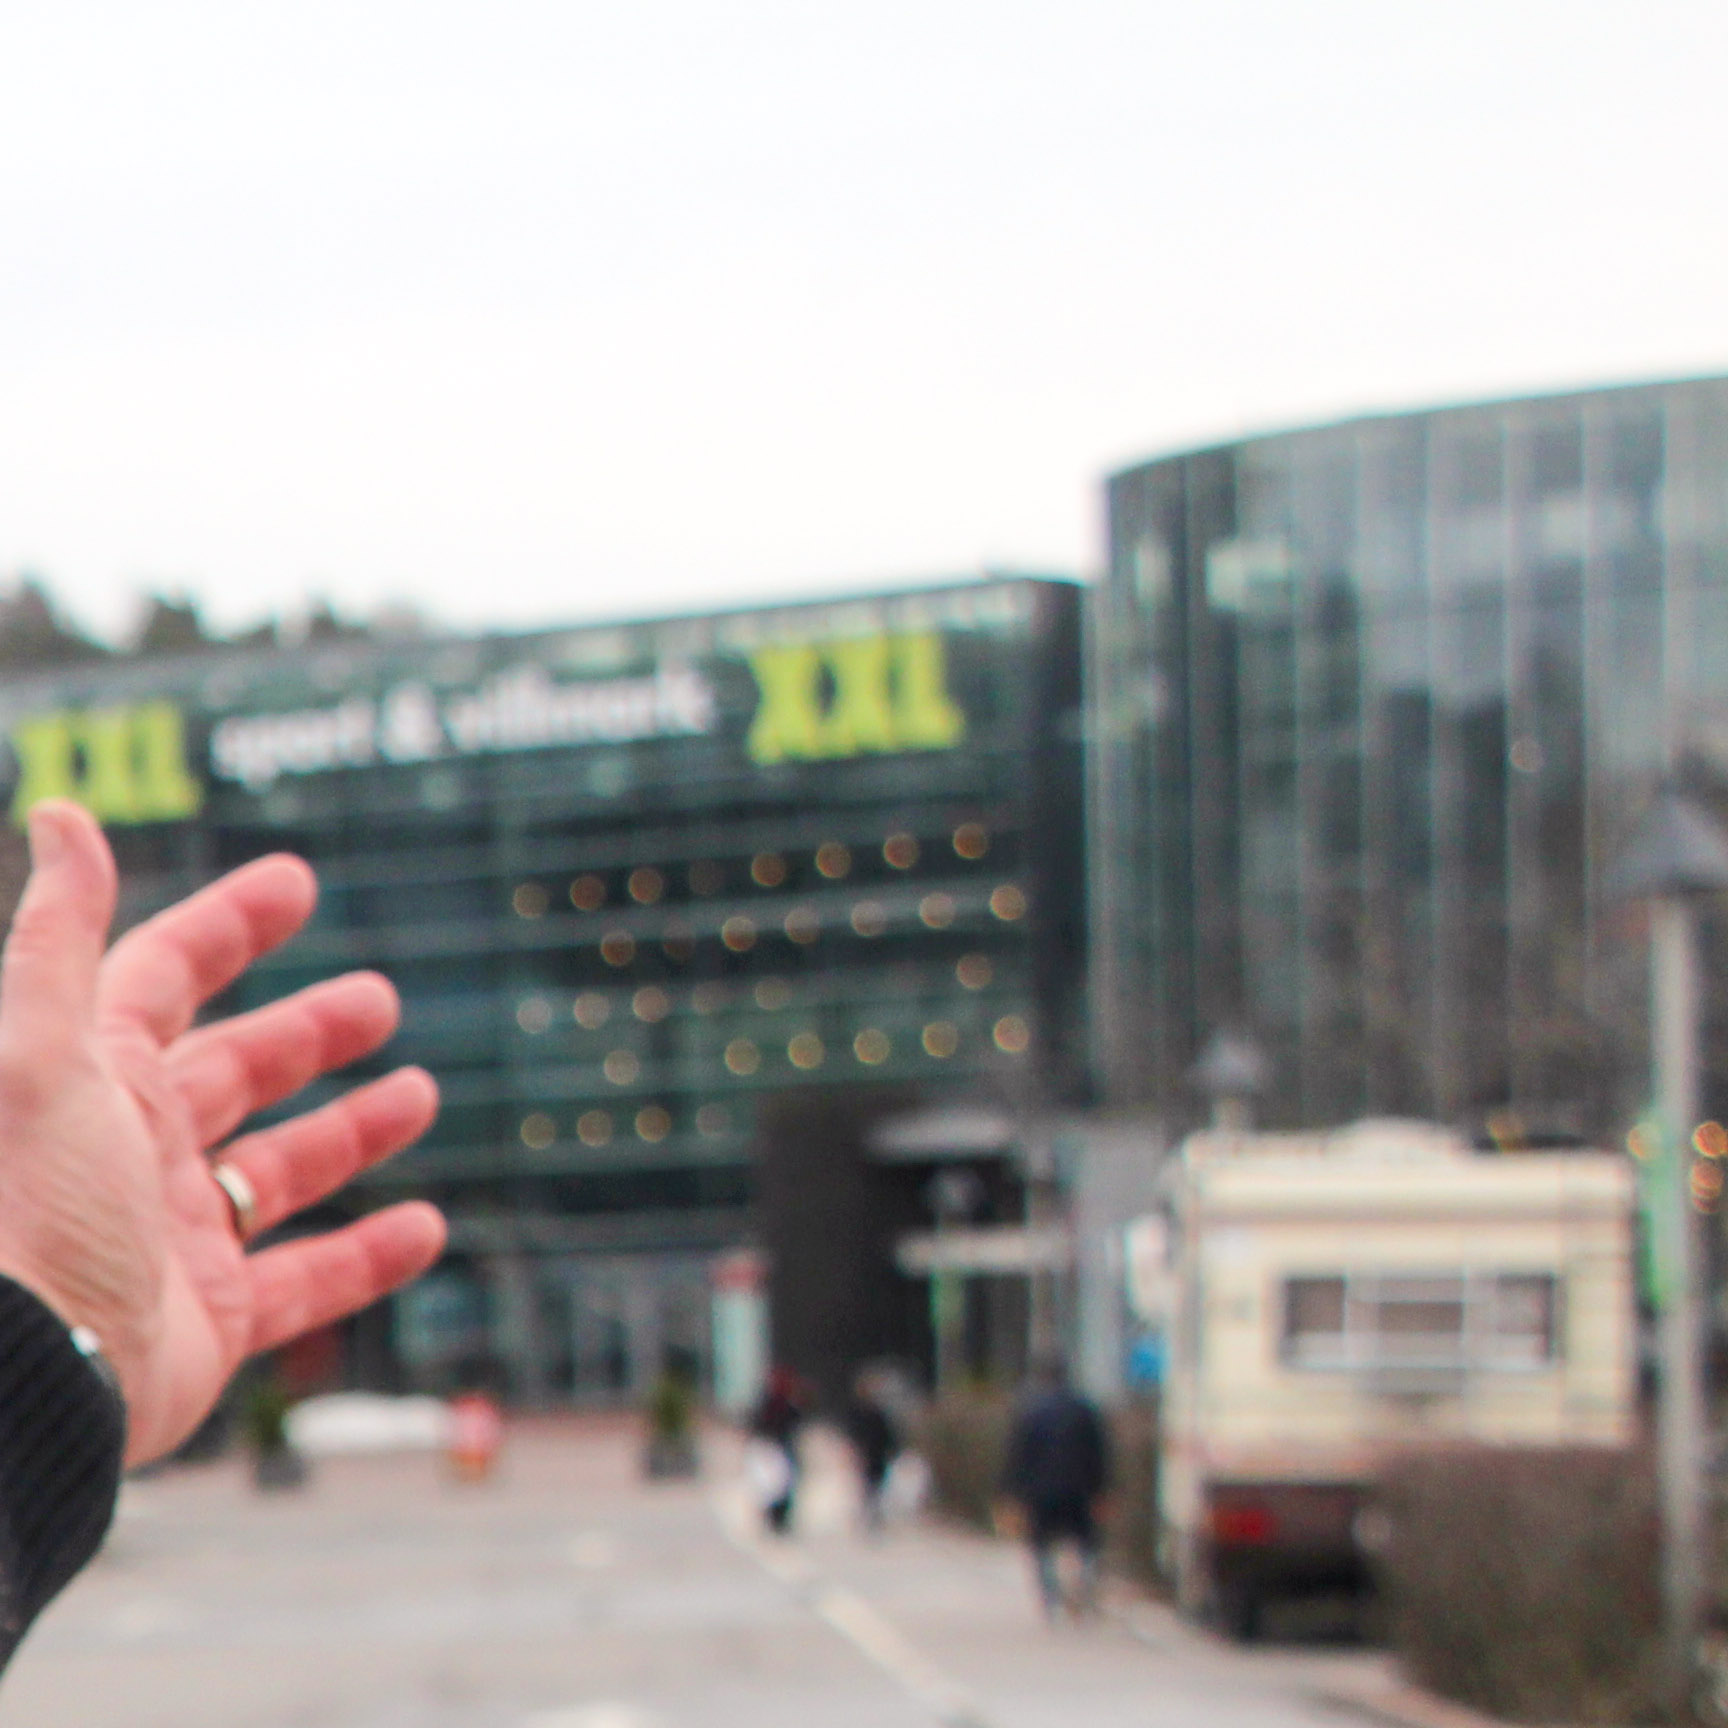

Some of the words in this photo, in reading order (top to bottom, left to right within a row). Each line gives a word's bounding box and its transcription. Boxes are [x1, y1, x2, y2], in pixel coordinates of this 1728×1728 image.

[11, 702, 204, 830] XXL
[211, 698, 376, 792] sport
[379, 682, 447, 764] &
[448, 660, 712, 756] villmark
[749, 628, 964, 765] XXL
